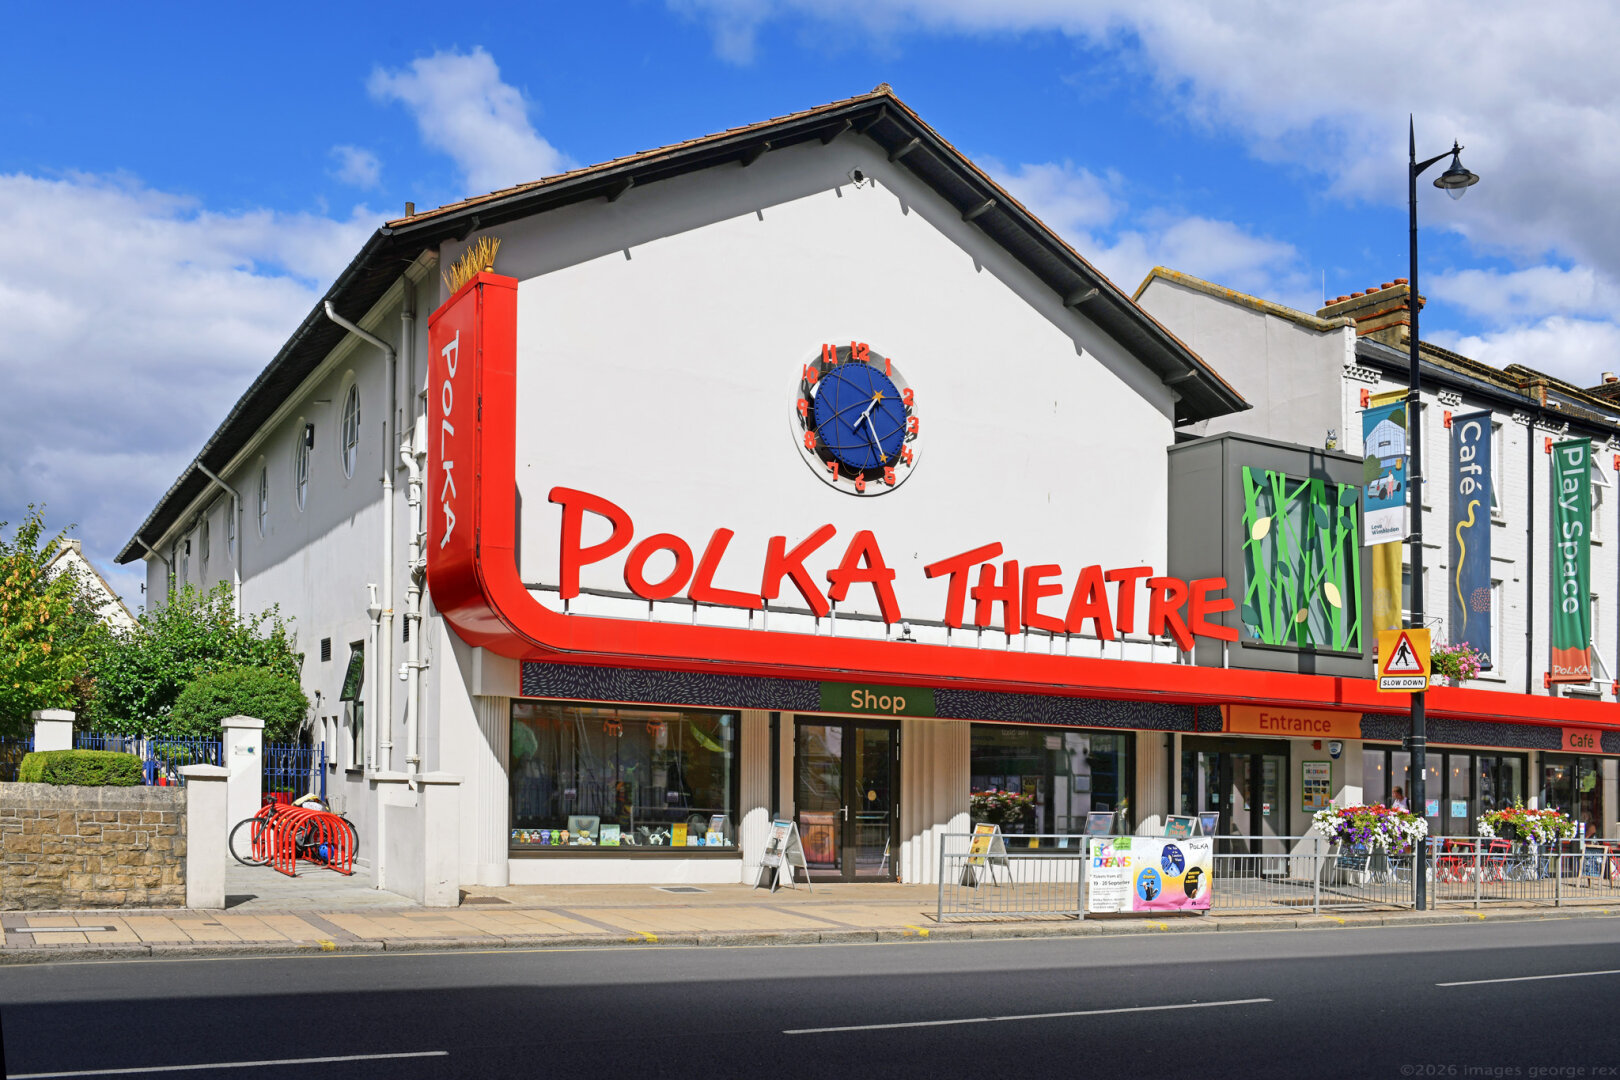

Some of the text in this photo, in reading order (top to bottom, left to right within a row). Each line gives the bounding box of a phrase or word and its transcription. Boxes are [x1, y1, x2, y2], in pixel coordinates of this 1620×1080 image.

[822, 343, 838, 364] 11
[850, 341, 870, 362] 12
[802, 363, 819, 384] 10
[885, 357, 892, 377] 1
[903, 387, 914, 406] 2
[797, 398, 809, 417] 9
[907, 416, 919, 434] 3
[440, 329, 460, 550] POLKA
[804, 430, 816, 449] 8
[901, 444, 913, 465] 4
[1460, 421, 1482, 495] Café
[826, 461, 839, 481] 7
[883, 465, 896, 486] 5
[855, 472, 866, 492] 6
[1371, 527, 1400, 535] Wimbledon
[1557, 446, 1585, 614] Play Space
[547, 486, 1239, 652] POLKA THEATRE
[1553, 665, 1590, 676] POLKA
[851, 689, 906, 714] Shop
[1259, 712, 1331, 733] Entrance
[1570, 733, 1594, 748] Café
[1093, 856, 1132, 868] DREAMS
